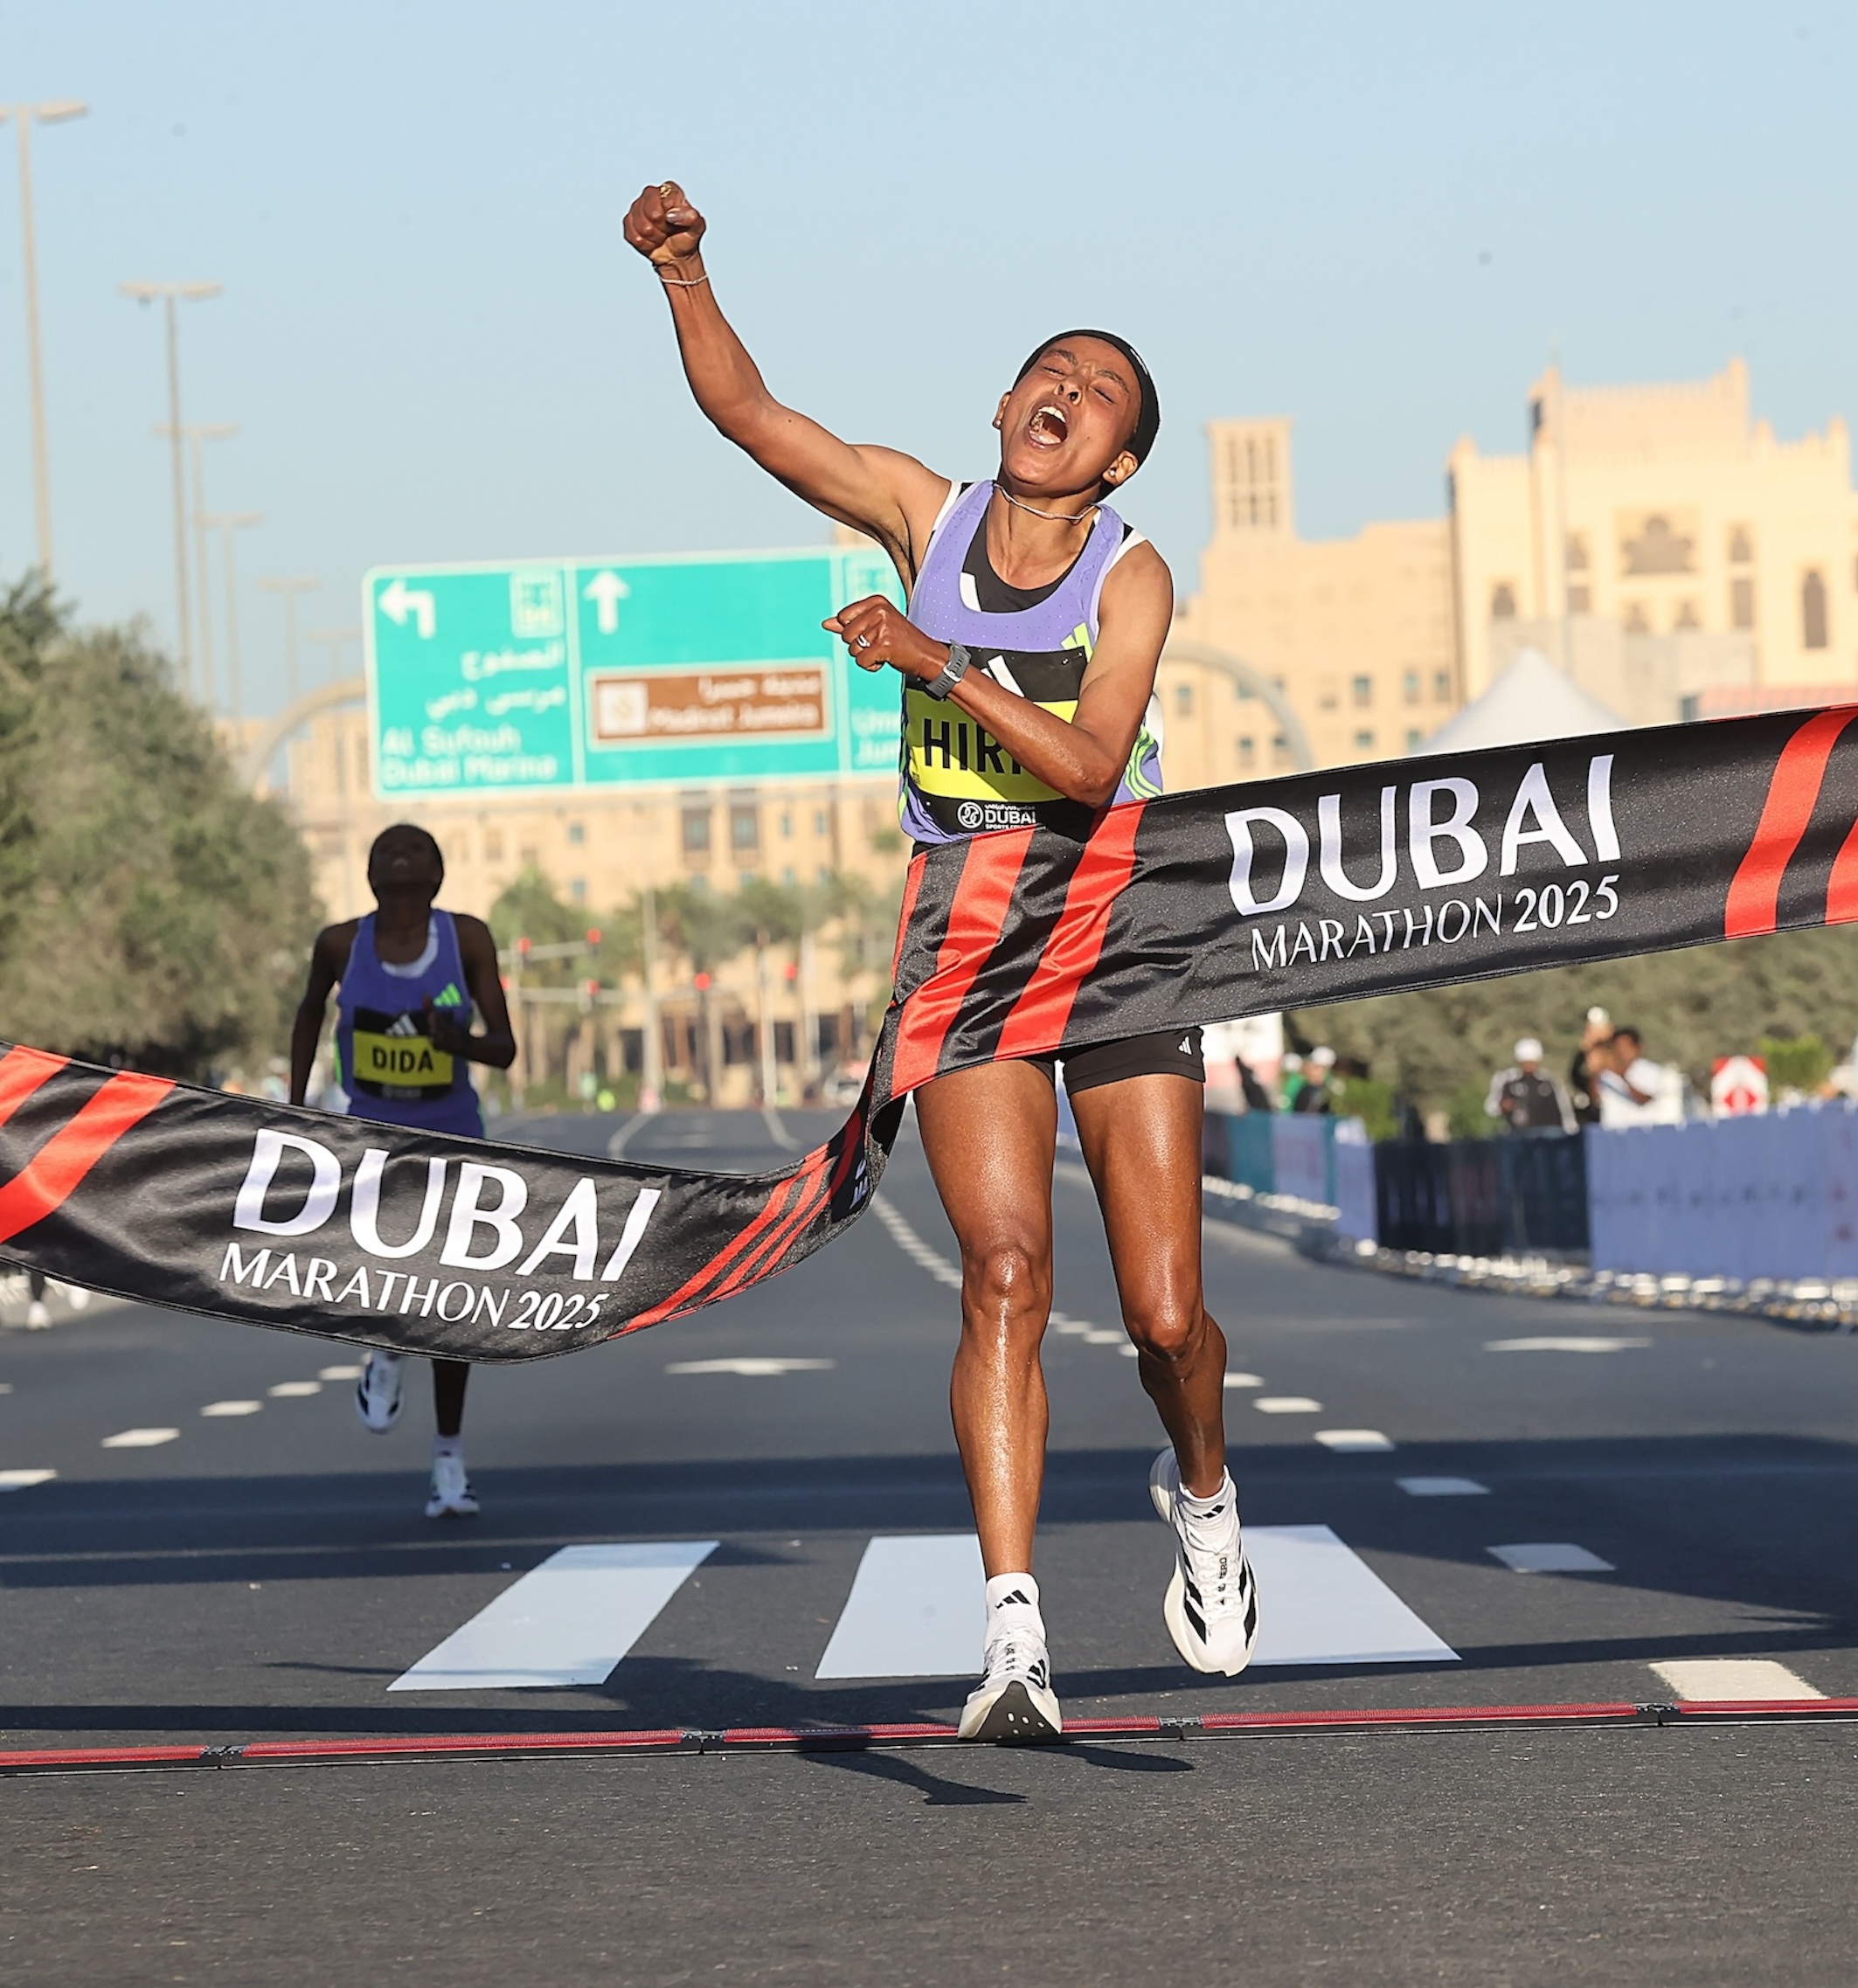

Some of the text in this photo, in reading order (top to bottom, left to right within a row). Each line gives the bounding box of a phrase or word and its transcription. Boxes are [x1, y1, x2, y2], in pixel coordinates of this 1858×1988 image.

[384, 754, 557, 786] Dubai Marina
[924, 718, 1021, 775] HIR
[985, 809, 1036, 824] DUBAI
[1224, 755, 1620, 916] DUBAI
[1252, 875, 1619, 972] MARATHON 2025
[372, 1048, 434, 1073] DIDA
[232, 1128, 662, 1282] DUBAI
[219, 1242, 610, 1331] MARATHON 2025
